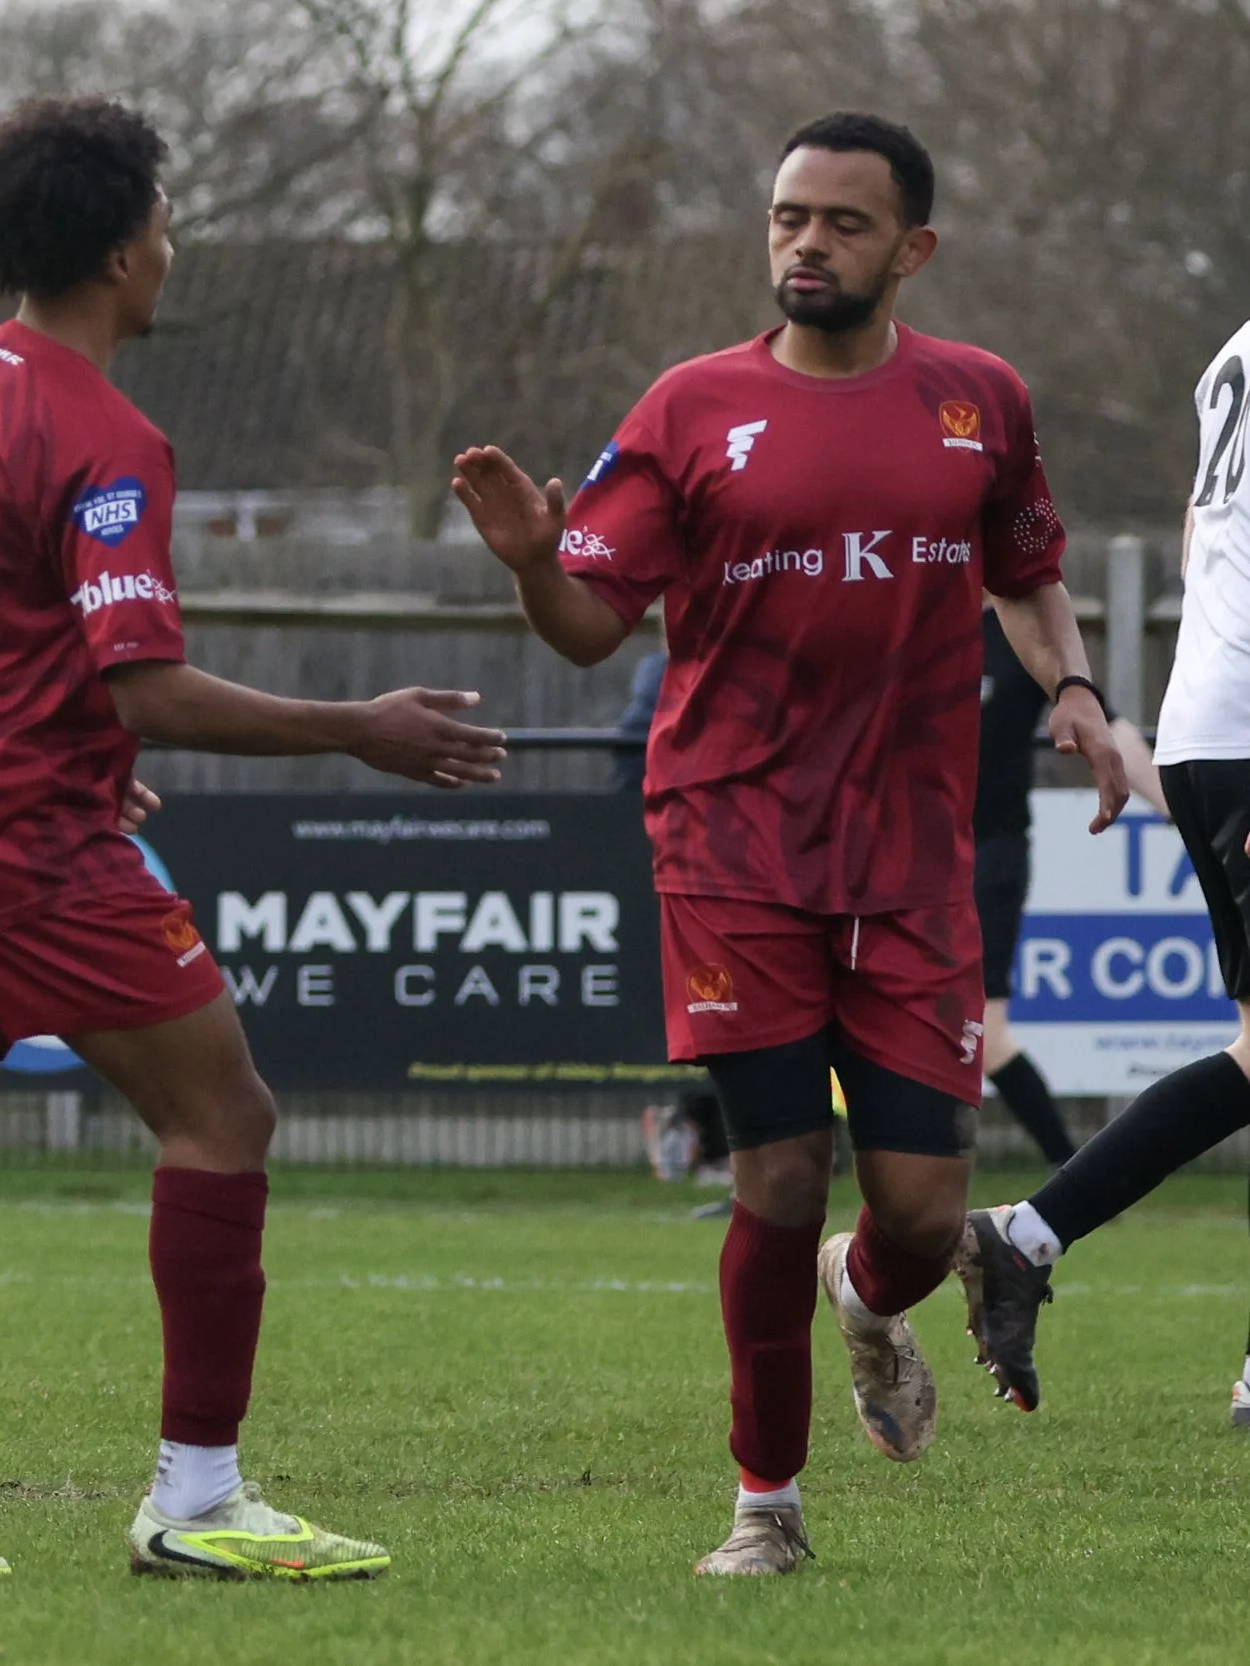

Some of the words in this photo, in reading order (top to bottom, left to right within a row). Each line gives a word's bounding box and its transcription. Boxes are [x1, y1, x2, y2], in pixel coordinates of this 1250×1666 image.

[91, 502, 131, 528] NHS
[842, 530, 894, 581] K
[216, 891, 619, 953] MAYFAIR
[220, 964, 334, 1007] WE
[394, 964, 619, 1007] CARE
